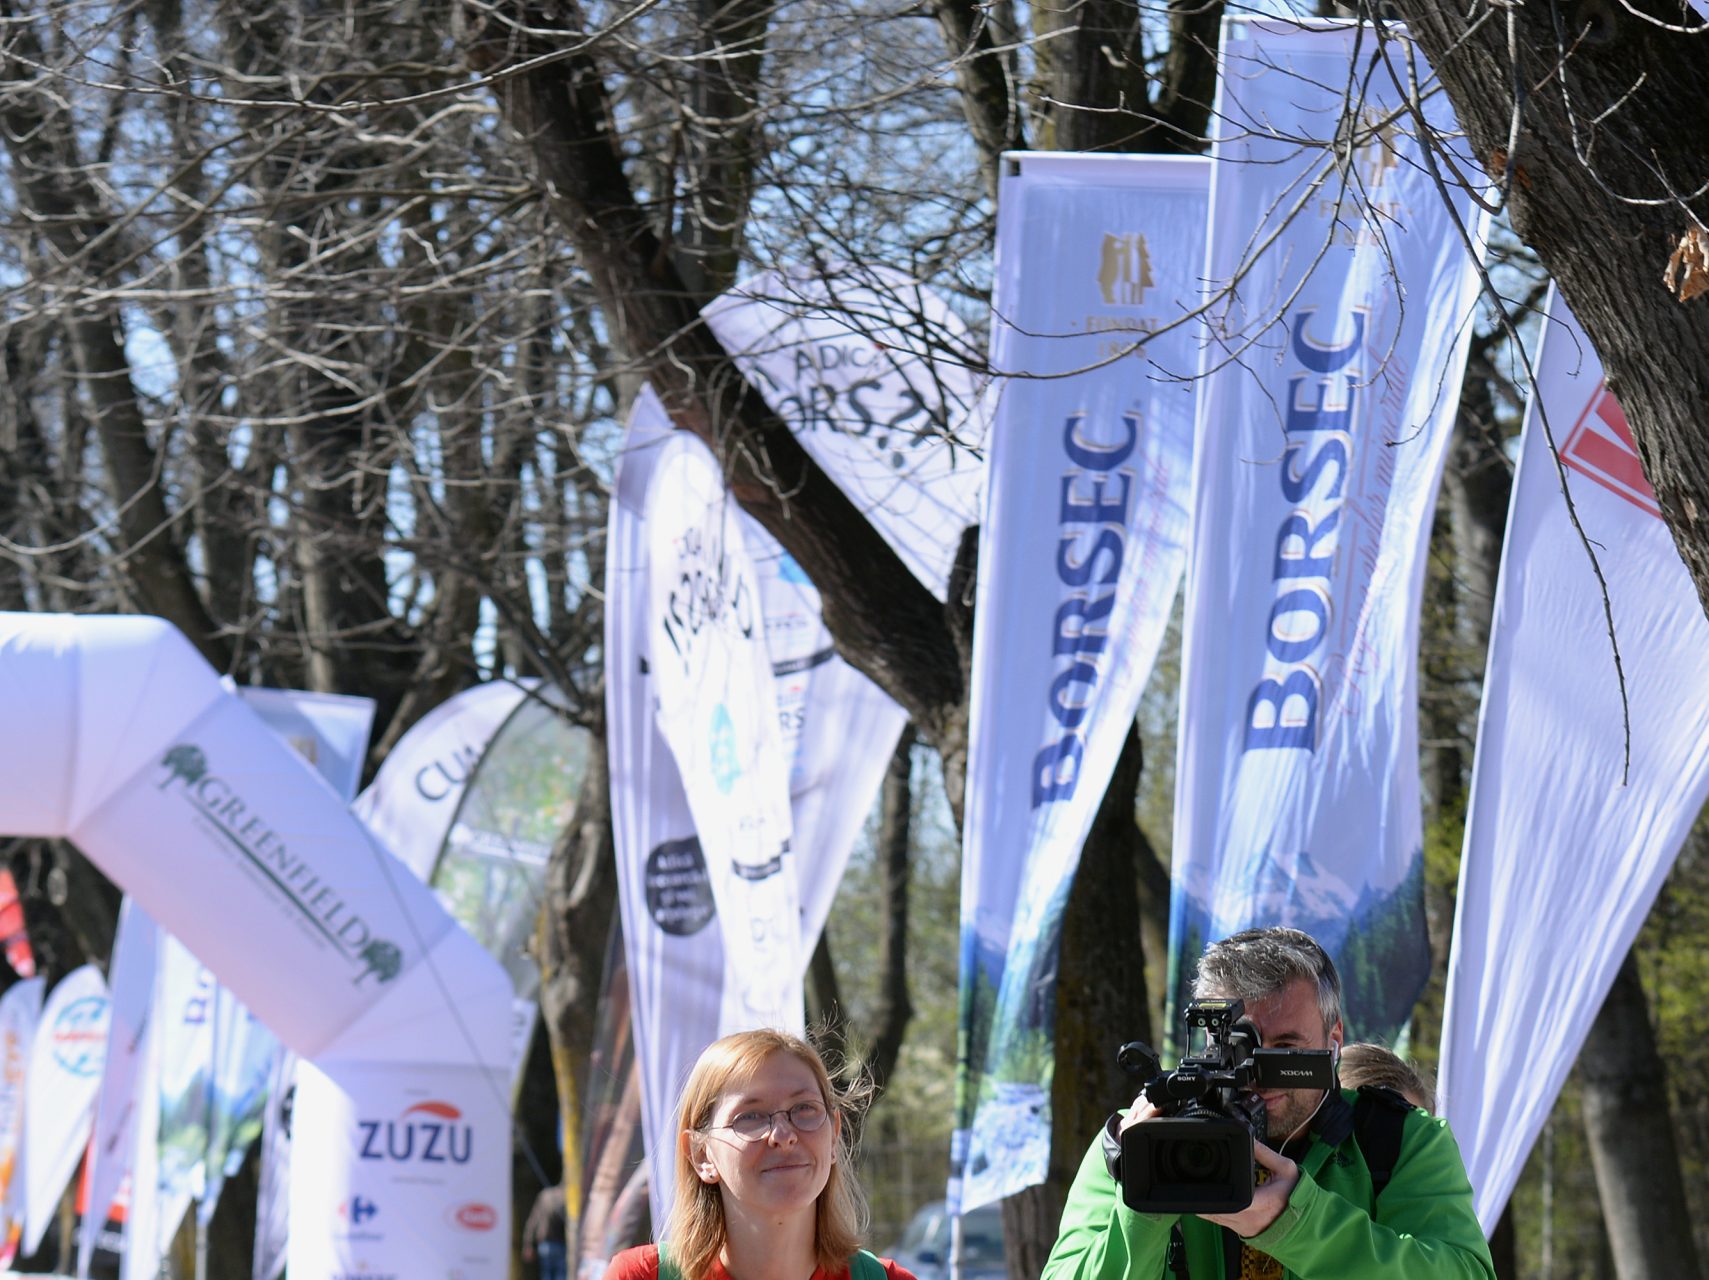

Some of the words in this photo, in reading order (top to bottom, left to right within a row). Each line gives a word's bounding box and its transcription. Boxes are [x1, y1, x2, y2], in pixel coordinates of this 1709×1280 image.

[1032, 410, 1142, 809] BORSEC
[1242, 305, 1373, 756] BORSEC
[196, 776, 374, 953] GREENFIELD
[359, 1119, 474, 1167] ZUZU
[1177, 1075, 1197, 1083] SONY
